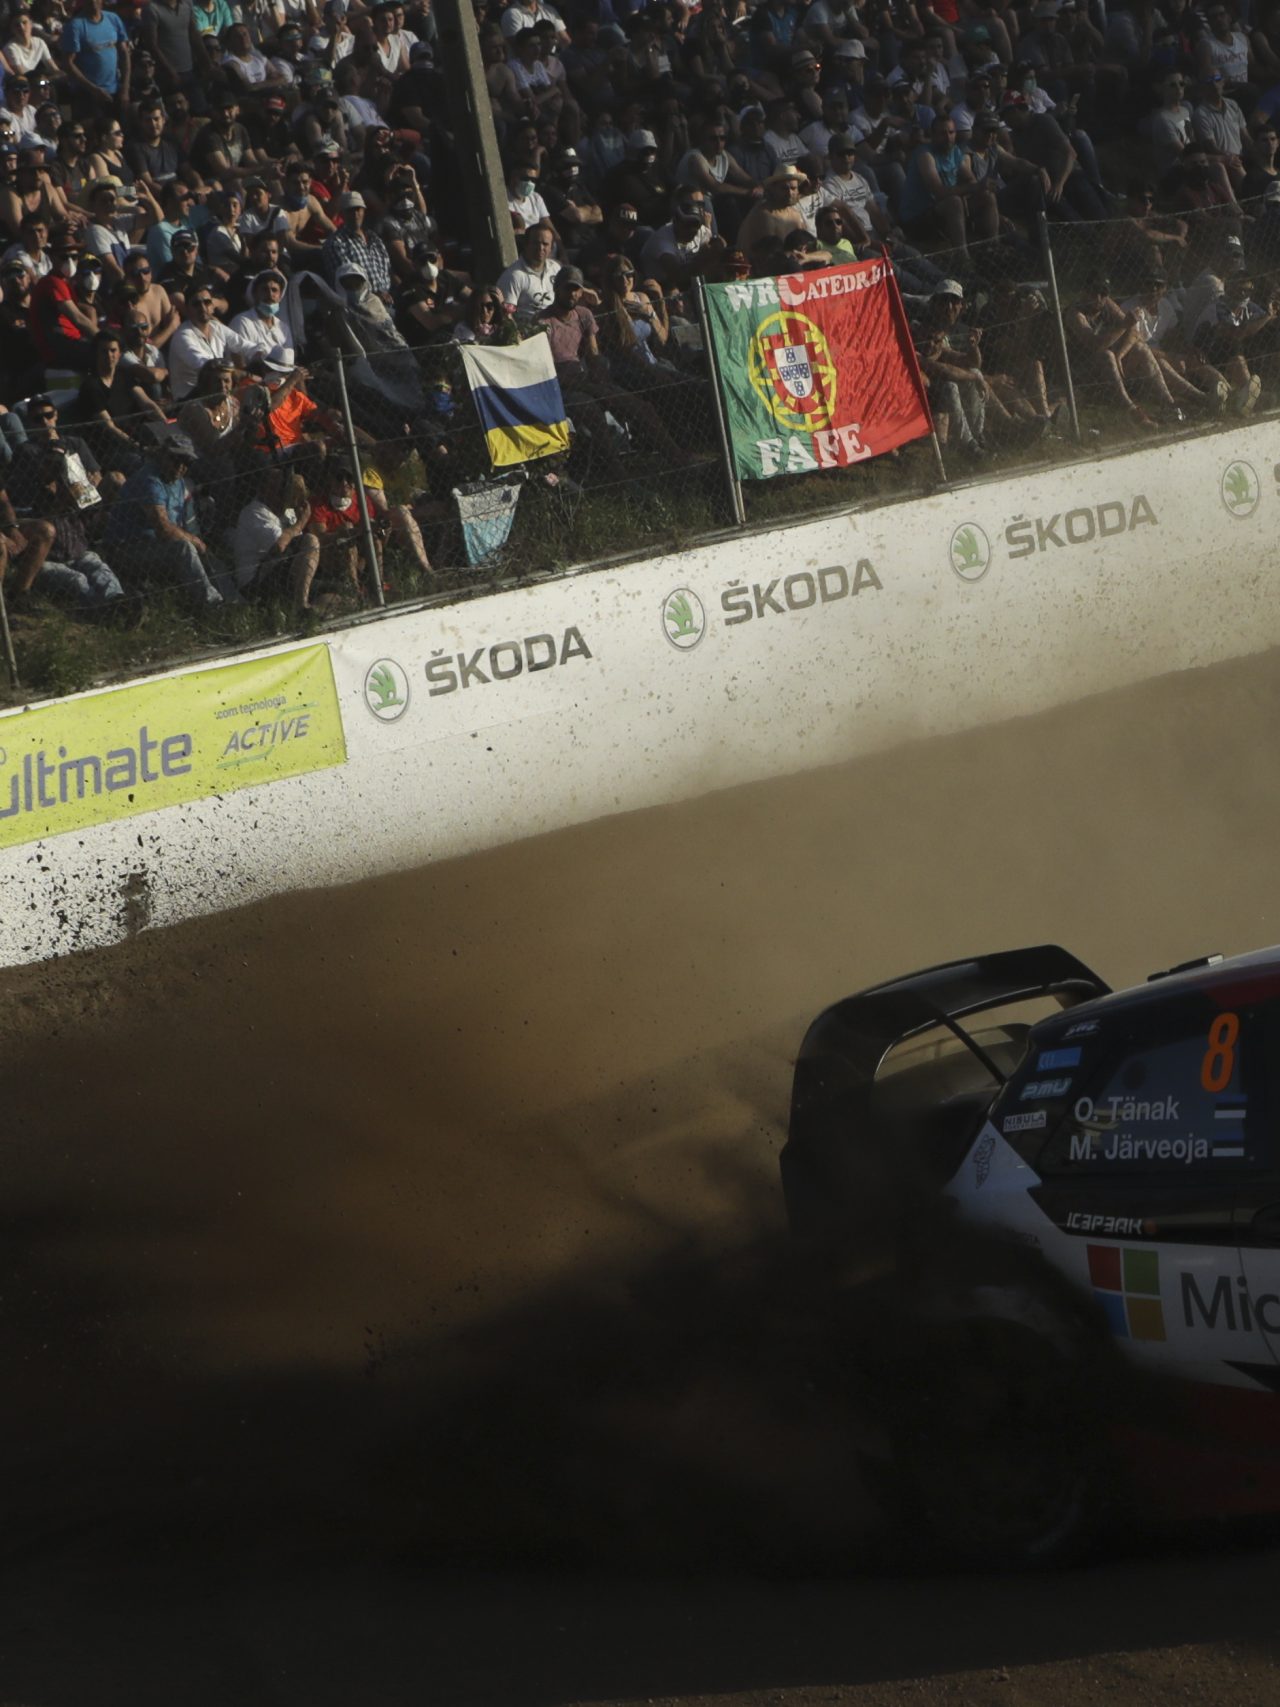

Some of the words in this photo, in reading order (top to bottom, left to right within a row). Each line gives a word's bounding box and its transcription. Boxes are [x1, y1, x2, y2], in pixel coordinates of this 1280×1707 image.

[757, 423, 872, 476] FAFE
[1005, 494, 1159, 559] ŠKODA
[720, 558, 883, 626] ŠKODA
[424, 626, 593, 697] ŠKODA
[223, 713, 311, 755] ACTIVE
[1201, 1012, 1240, 1093] 8
[1074, 1096, 1099, 1122] O.
[1107, 1095, 1180, 1121] Tänak
[1069, 1135, 1097, 1161] M.
[1104, 1132, 1209, 1165] Järveoja
